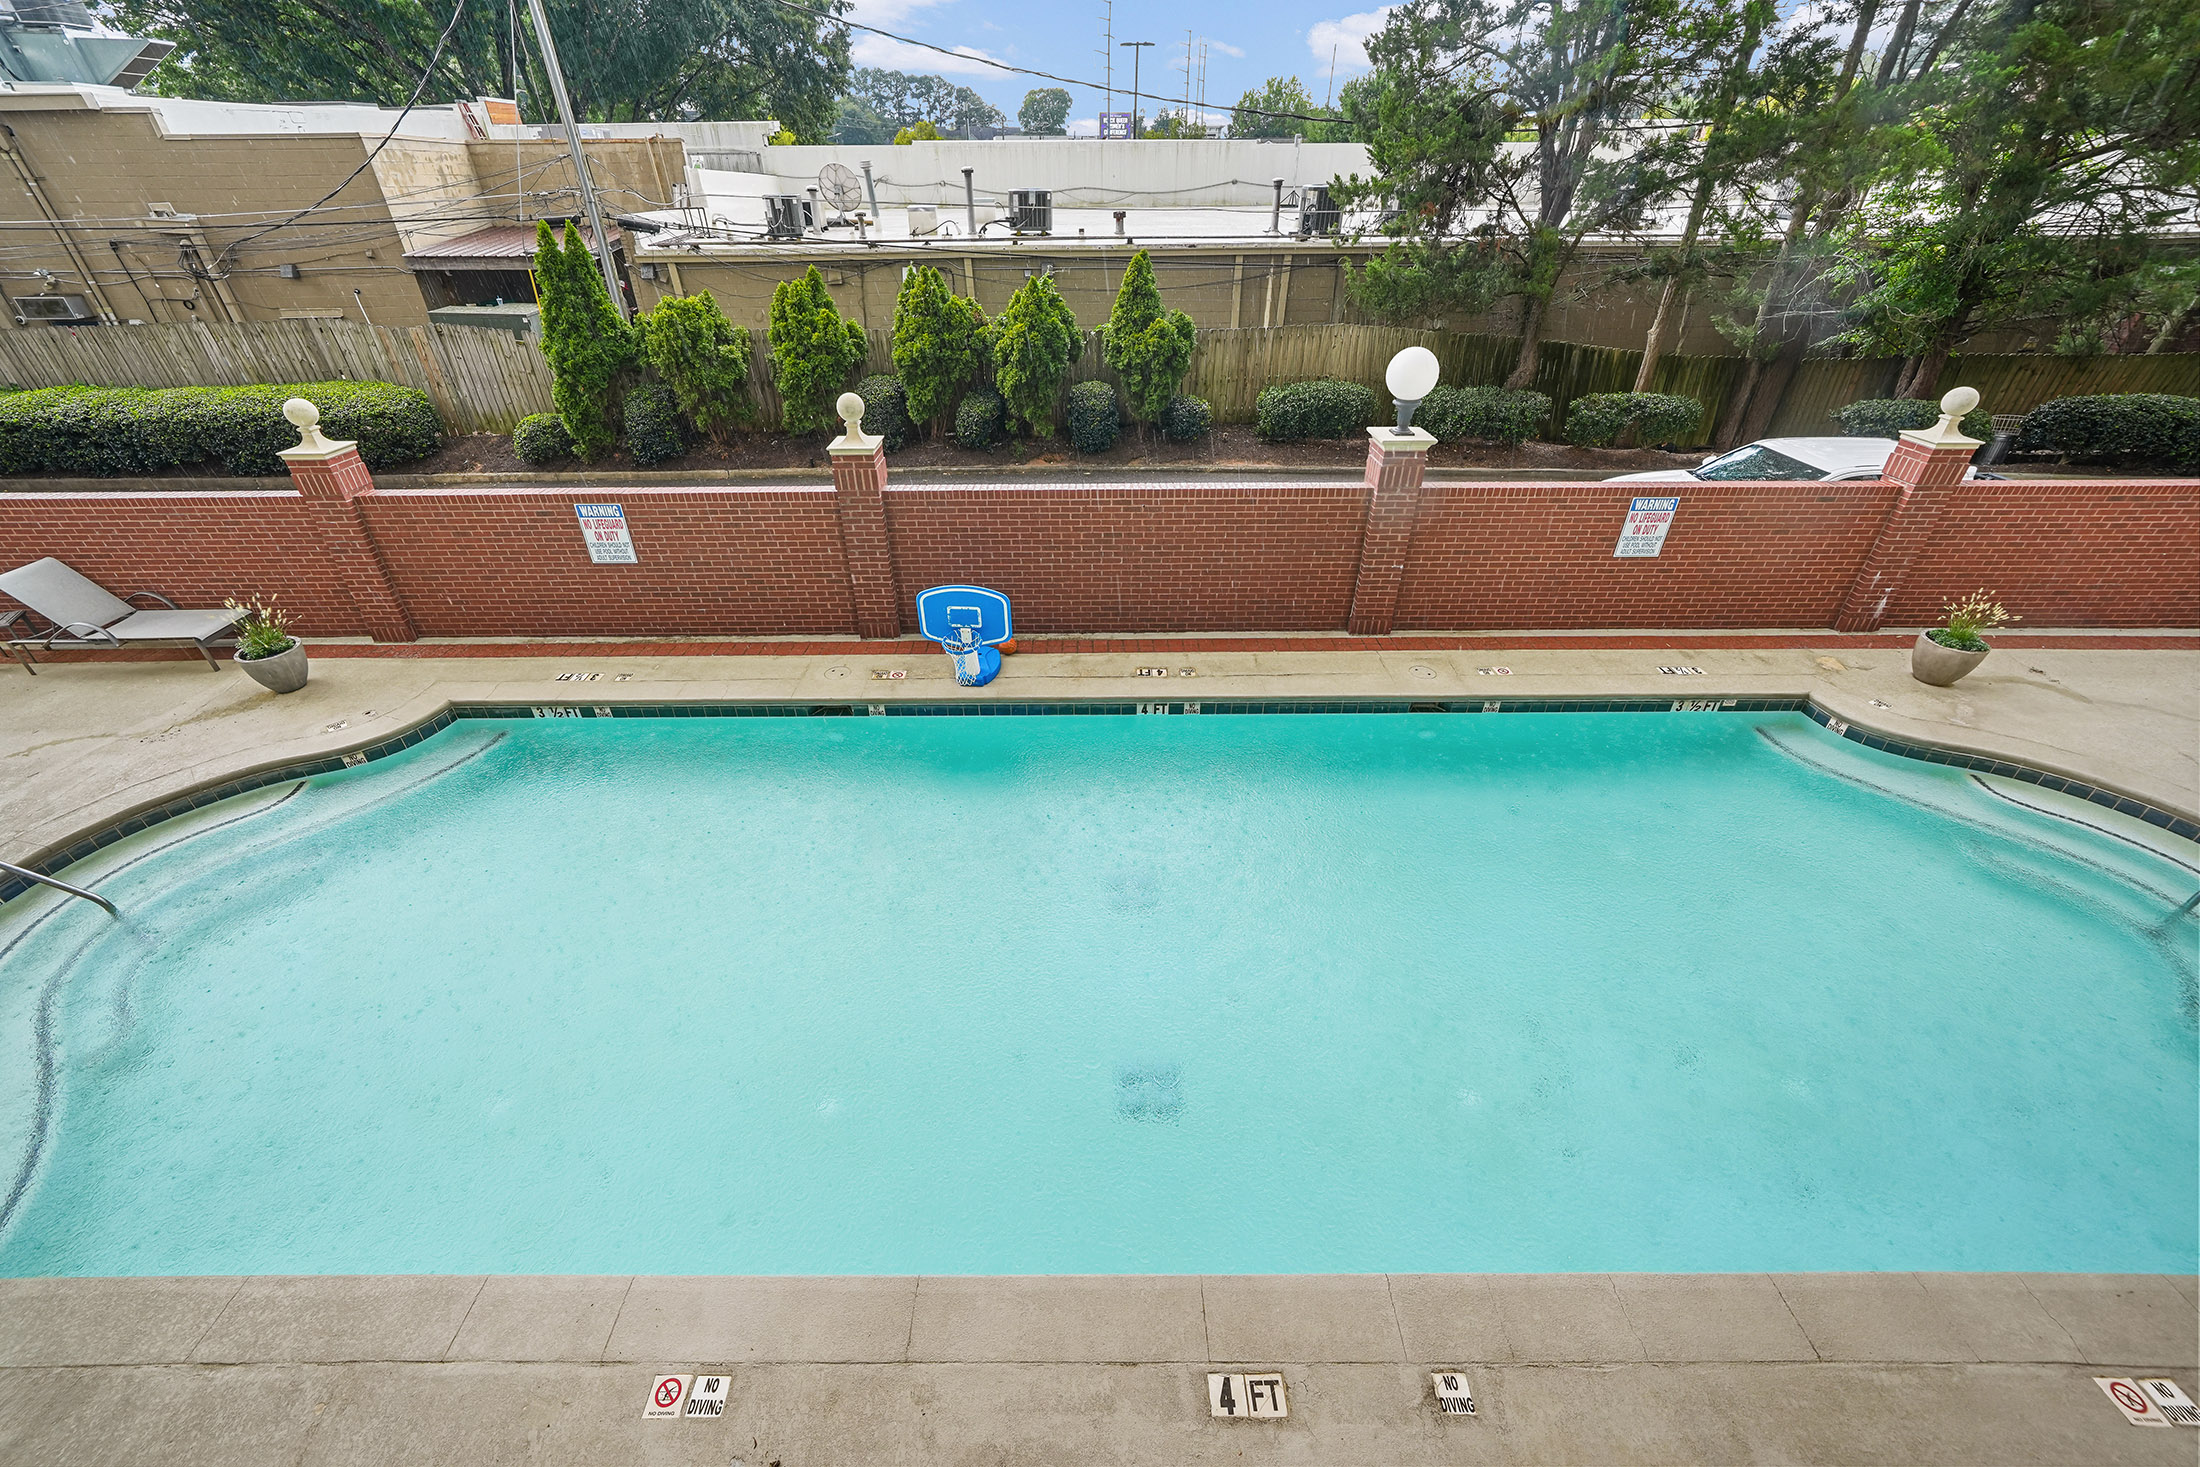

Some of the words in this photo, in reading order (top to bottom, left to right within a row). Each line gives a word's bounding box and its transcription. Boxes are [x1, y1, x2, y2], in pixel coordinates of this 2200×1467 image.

[578, 505, 621, 517] WARNING
[1634, 499, 1675, 511] WARNING
[1629, 512, 1639, 523] NO
[1639, 512, 1671, 523] LIFEGUARD
[582, 519, 592, 530] NO
[592, 519, 624, 530] LIFEGUARD
[1632, 524, 1643, 535] ON
[1642, 524, 1660, 535] DUTY
[594, 530, 604, 541] ON
[603, 530, 620, 541] DUTY
[536, 706, 546, 718] 3
[563, 706, 580, 718] FT
[1140, 703, 1149, 715] 4
[1153, 703, 1168, 715] FT
[1675, 700, 1685, 712] 3
[1702, 701, 1719, 712] FT
[1835, 720, 1843, 728] NO
[346, 757, 367, 768] DIVING
[348, 753, 358, 761] NO
[703, 1377, 720, 1394] NO
[1442, 1375, 1459, 1391] NO
[1220, 1376, 1237, 1416] 4
[1249, 1379, 1280, 1412] FT
[2149, 1381, 2175, 1399] NO
[686, 1399, 724, 1416] DIVING
[1439, 1396, 1476, 1413] DIVING
